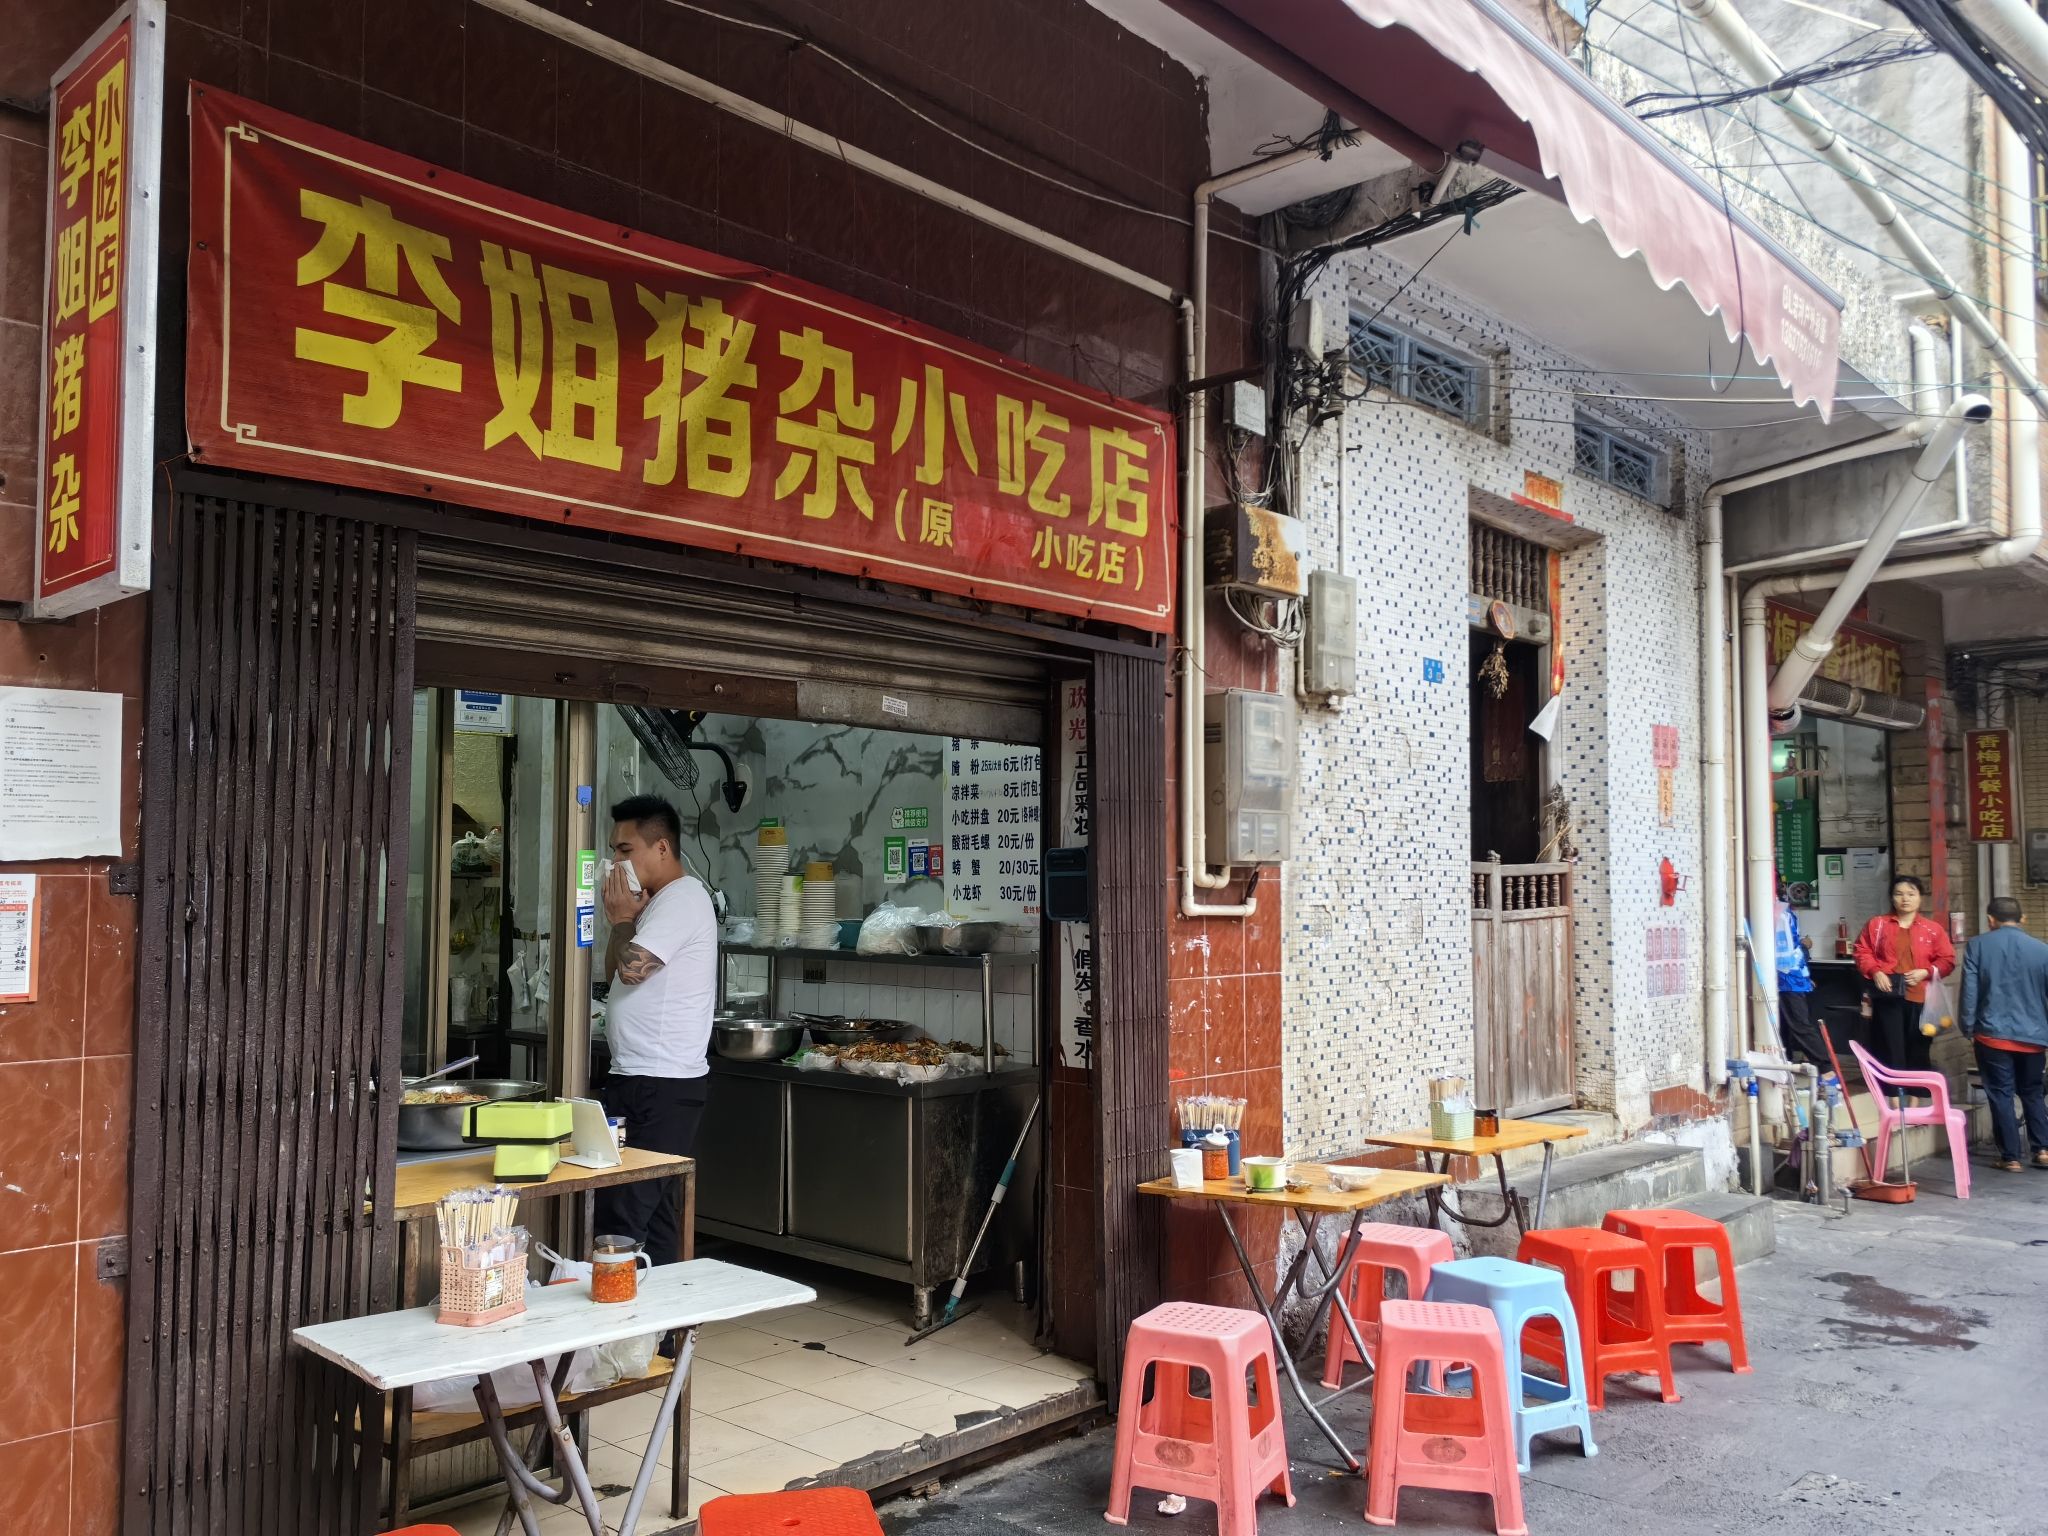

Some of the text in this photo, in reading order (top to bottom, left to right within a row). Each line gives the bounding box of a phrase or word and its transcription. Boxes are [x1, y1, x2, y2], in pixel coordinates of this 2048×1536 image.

[93, 76, 122, 310] 小吃店
[48, 106, 92, 554] 李姐猪杂
[294, 188, 1150, 538] 李姐猪杂小吃店
[1031, 526, 1145, 592] 小吃店)
[951, 783, 980, 801] 凉拌菜
[1976, 734, 2006, 839] 香梅早餐小吃店
[951, 808, 990, 826] 小吃拼盘
[951, 832, 1035, 851] 酸甜毛螺 20元/份
[952, 858, 1040, 876] 螃蟹 20/30元
[952, 883, 1037, 902] 小龙虾 30元/份
